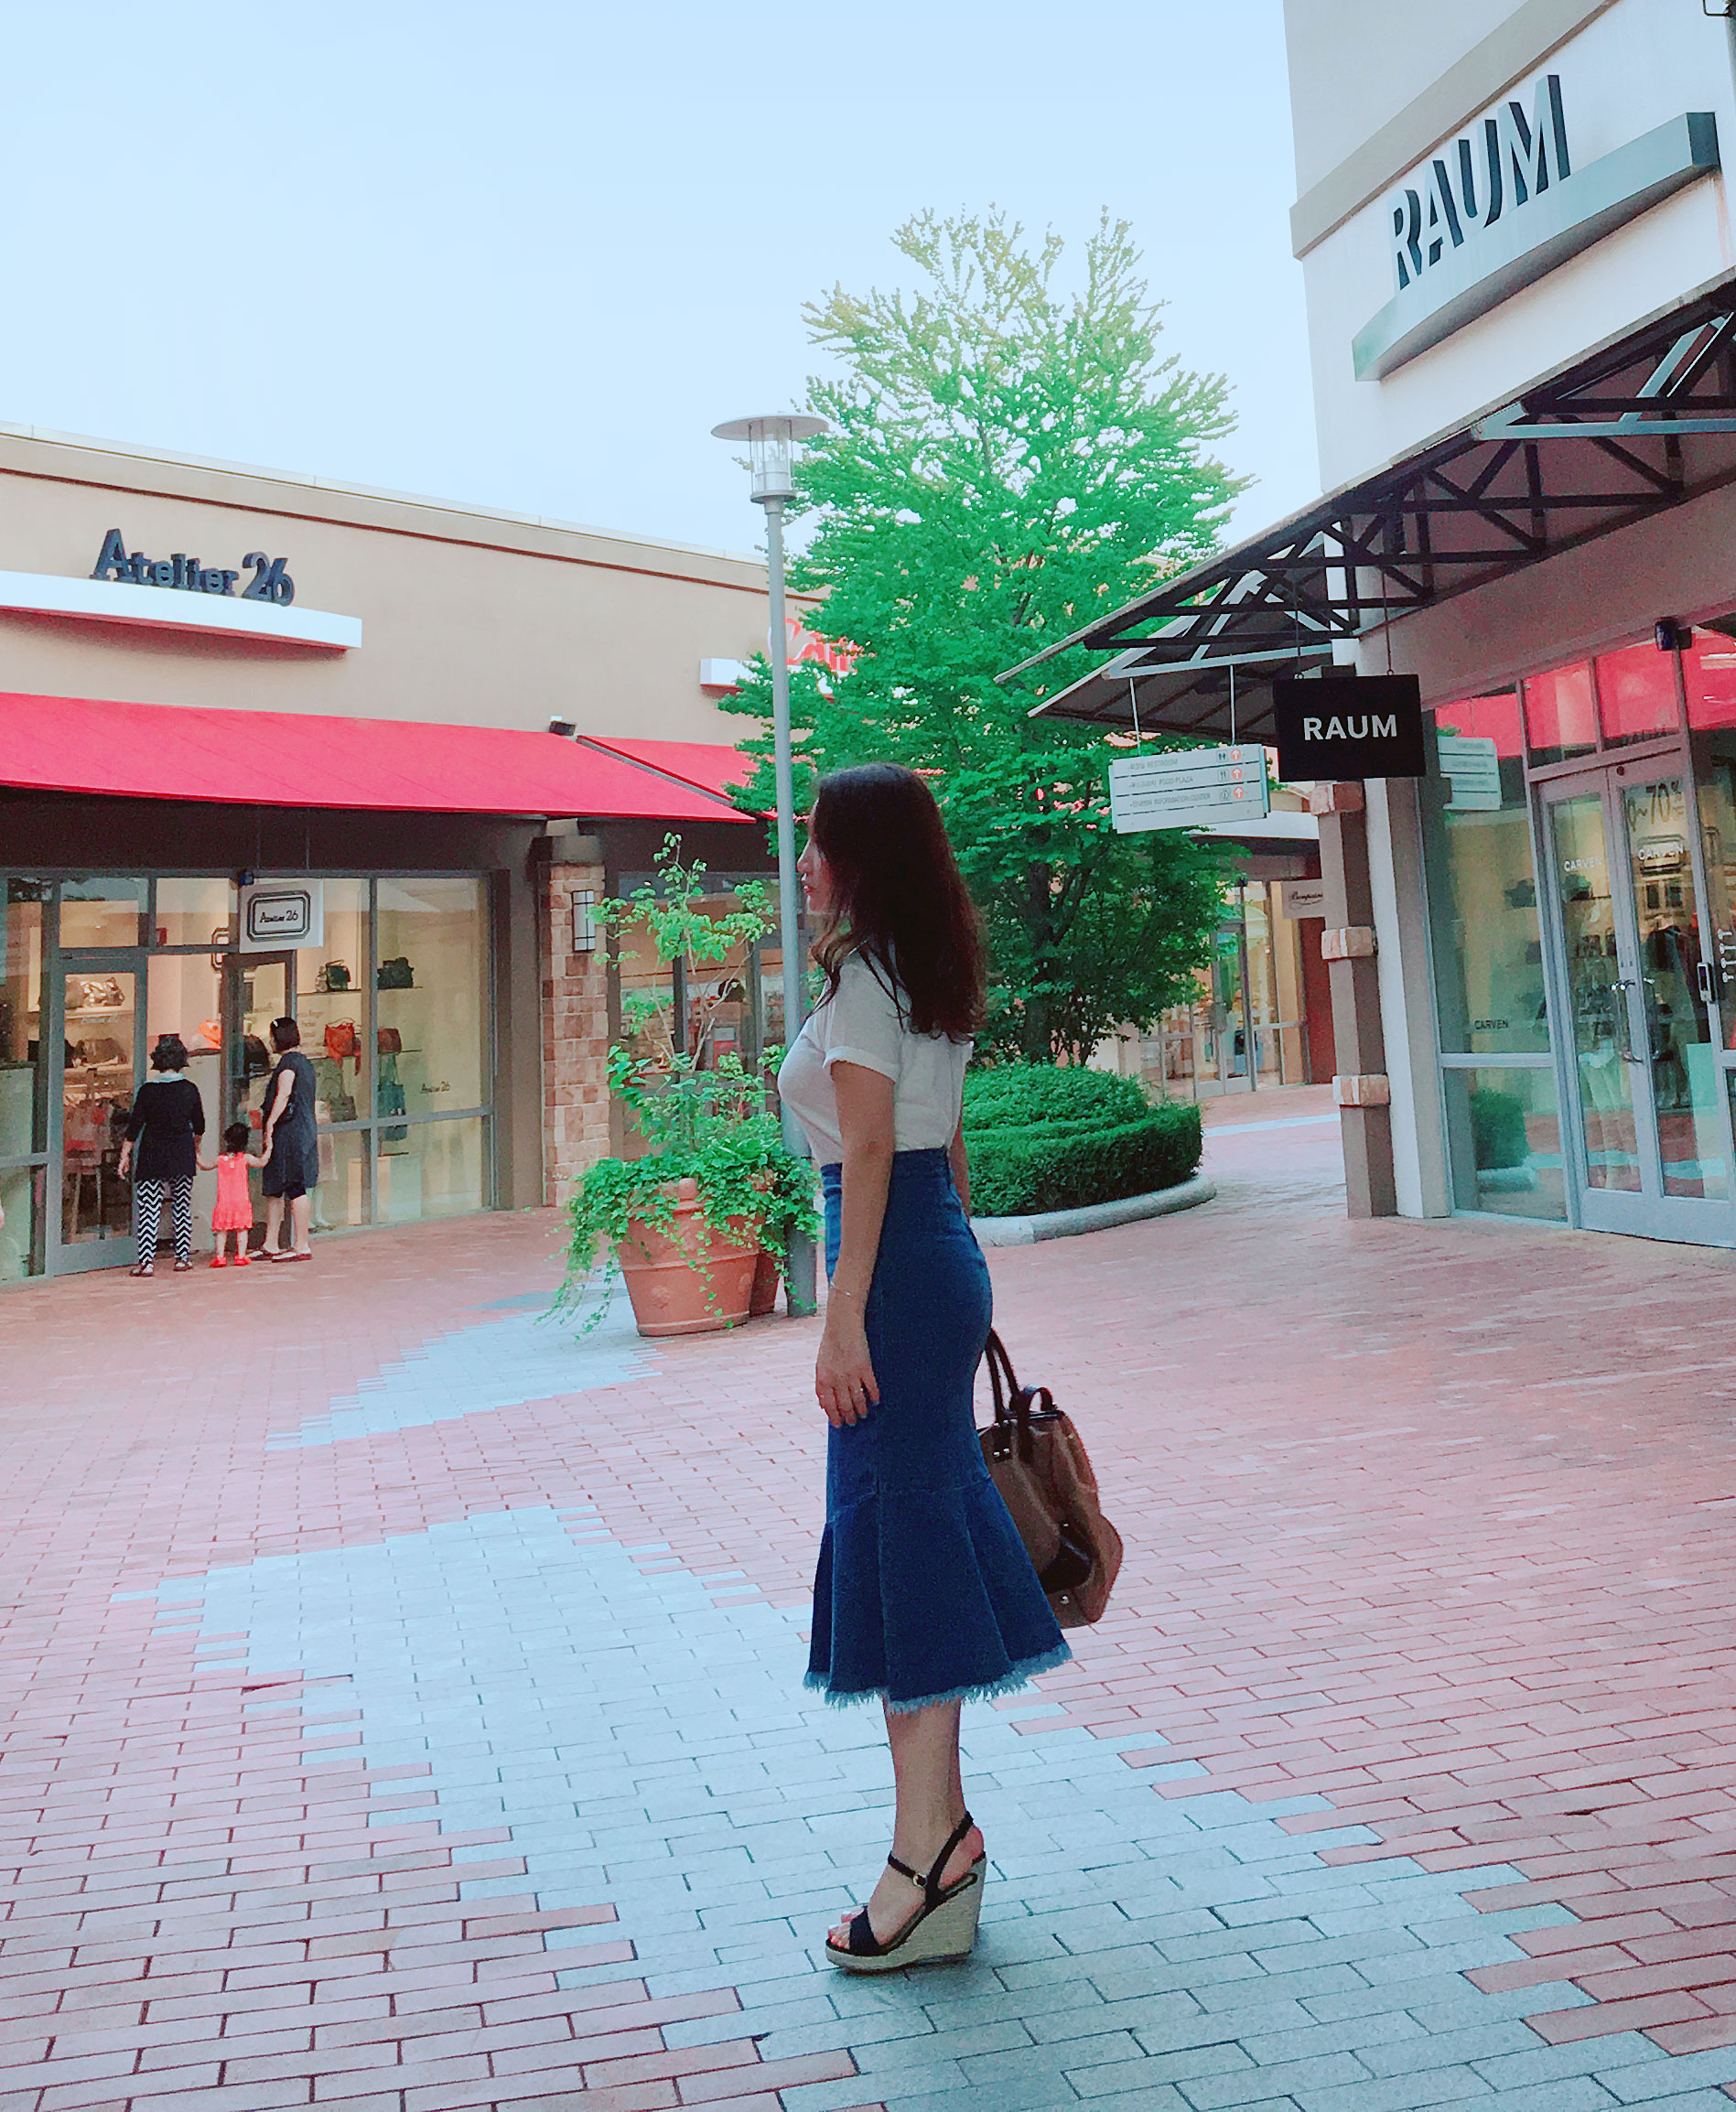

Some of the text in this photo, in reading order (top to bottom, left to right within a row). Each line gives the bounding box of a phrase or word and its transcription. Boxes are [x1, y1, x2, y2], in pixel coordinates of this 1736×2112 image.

[1387, 74, 1571, 292] RAUM
[89, 528, 296, 607] Atelier 26
[1303, 714, 1397, 741] RAUM
[1563, 856, 1603, 873] CARVEN
[286, 910, 299, 921] 26
[1473, 1018, 1509, 1030] CARVEN
